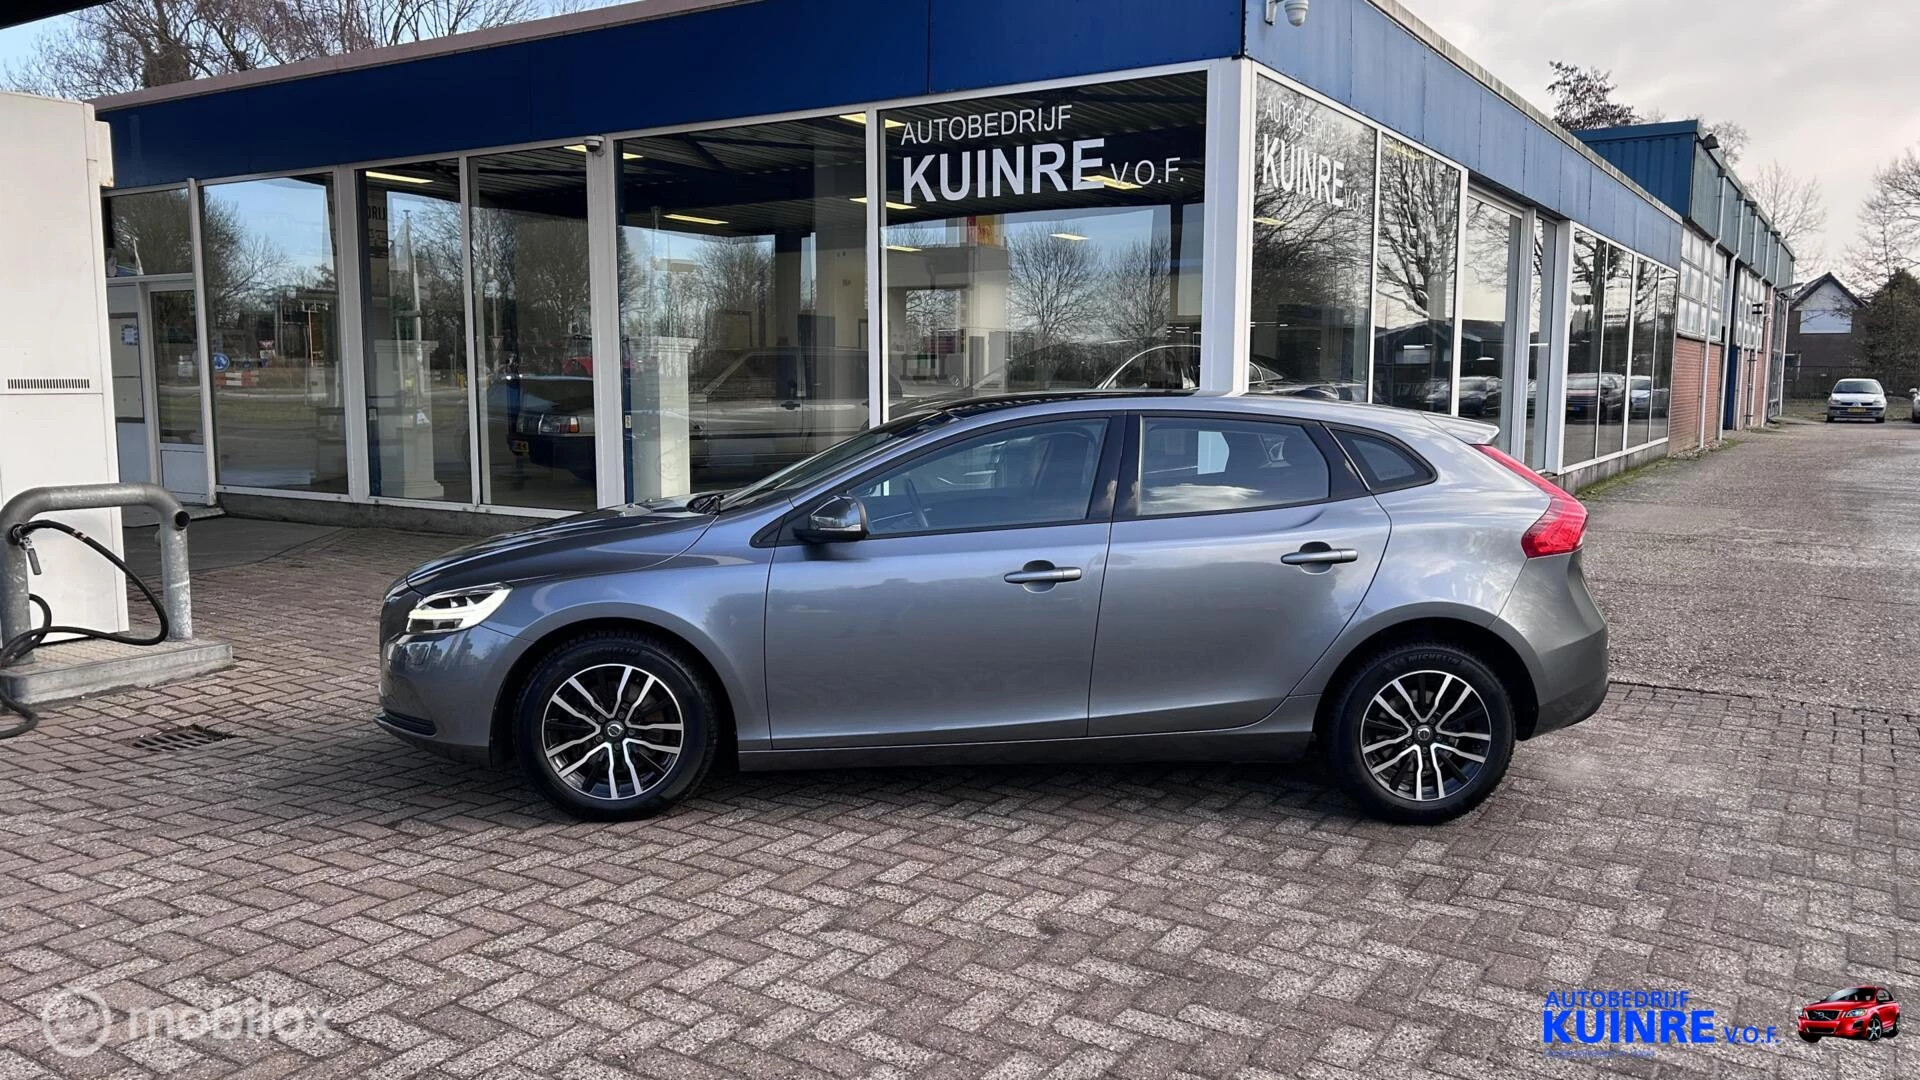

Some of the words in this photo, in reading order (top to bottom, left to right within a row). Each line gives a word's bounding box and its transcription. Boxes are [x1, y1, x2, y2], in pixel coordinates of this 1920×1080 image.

[901, 104, 1072, 146] AUTOBEDRIJF
[1264, 96, 1336, 144] AUTOBEDRIJF
[903, 138, 1105, 204] KUINRE
[1110, 157, 1184, 185] V.O.F.
[1262, 133, 1344, 208] KUINRE
